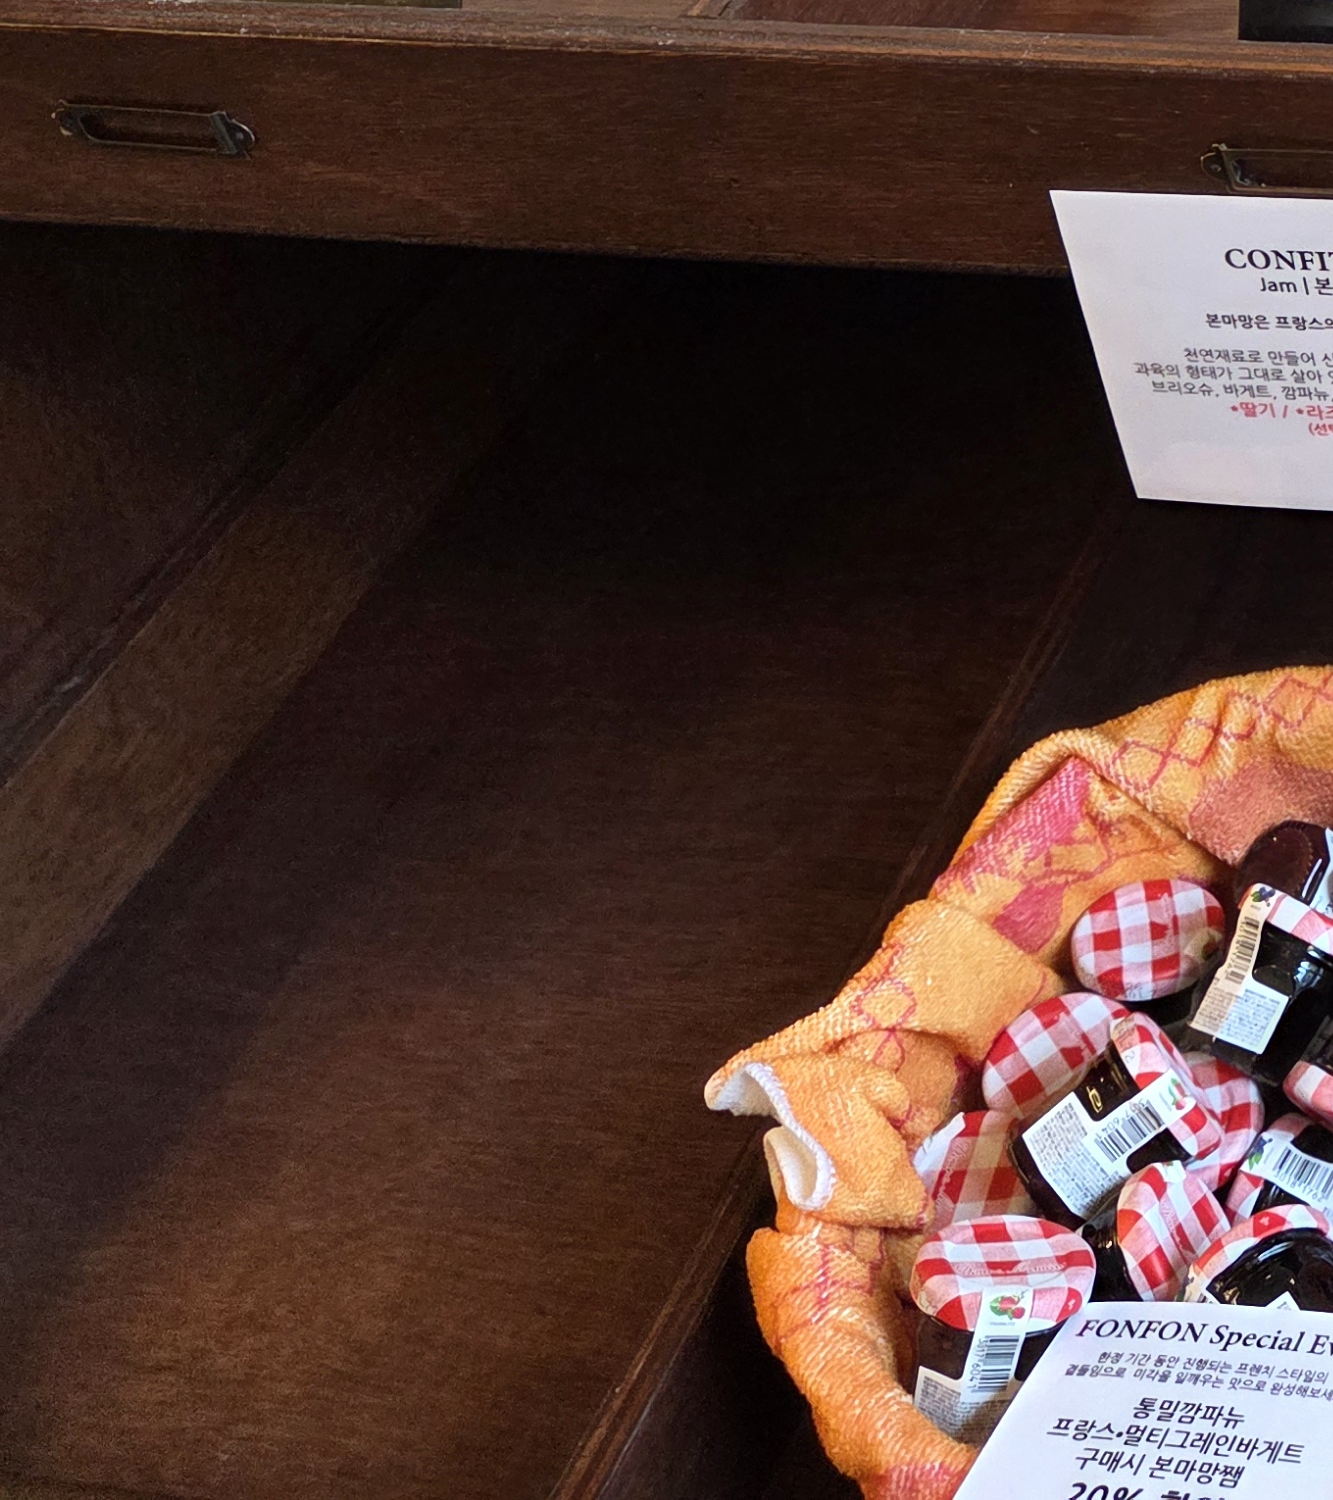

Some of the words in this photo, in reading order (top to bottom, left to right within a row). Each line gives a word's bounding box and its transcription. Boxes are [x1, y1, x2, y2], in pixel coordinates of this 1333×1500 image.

[1260, 277, 1297, 292] Jam
[1205, 313, 1270, 330] 본마망은
[1184, 347, 1264, 363] 천연재료로
[1267, 350, 1316, 366] 만들어
[1151, 380, 1219, 397] 브리오슈,
[1222, 383, 1277, 400] 바게트,
[1075, 1319, 1208, 1342] FONFON
[1209, 1324, 1305, 1351] Special
[1064, 1364, 1127, 1378] 곁들임으로
[1133, 1368, 1171, 1382] 미각을
[1174, 1371, 1223, 1388] 일깨우는
[1227, 1377, 1267, 1391] 맛으로
[1097, 1351, 1124, 1364] 한정
[1124, 1352, 1151, 1366] 기간
[1153, 1354, 1179, 1368] 동안
[1182, 1357, 1232, 1373] 진행되는
[1234, 1362, 1275, 1377] 프렌치
[1275, 1368, 1328, 1384] 스타일의
[1133, 1397, 1244, 1429] 통밀깜파뉴
[1075, 1447, 1146, 1475] 구매시
